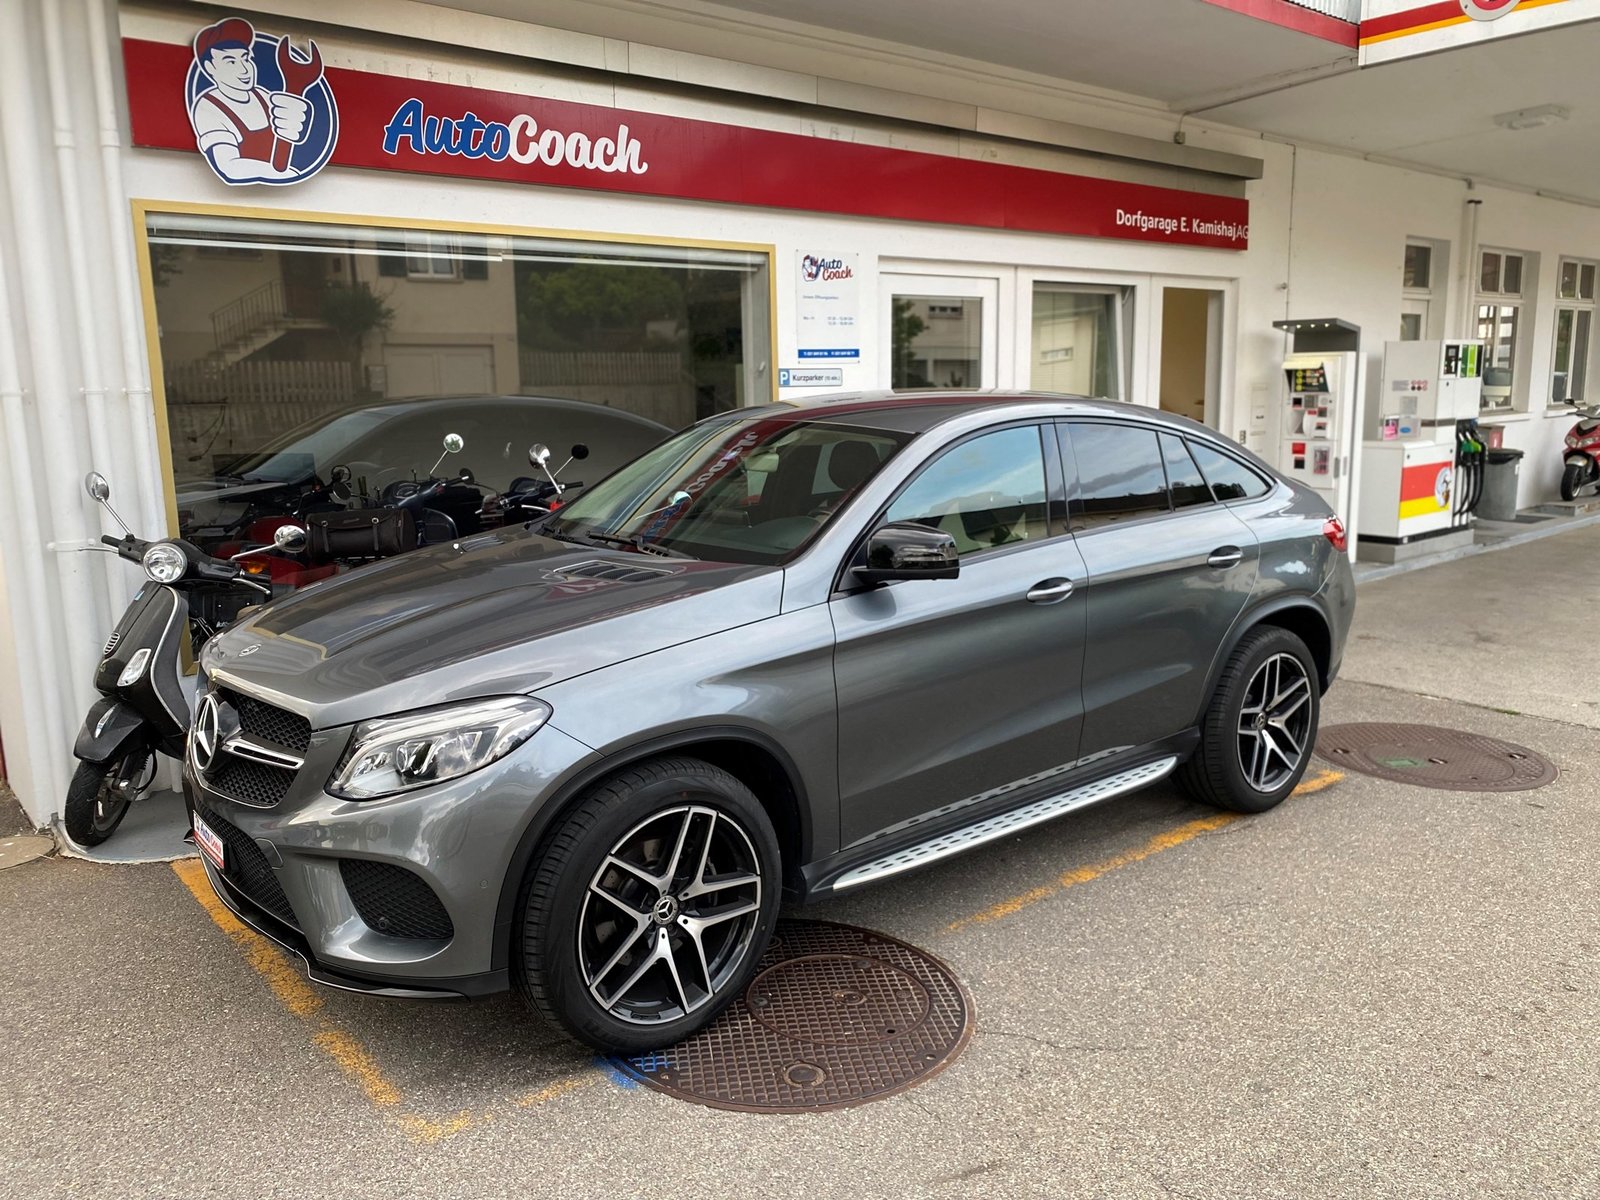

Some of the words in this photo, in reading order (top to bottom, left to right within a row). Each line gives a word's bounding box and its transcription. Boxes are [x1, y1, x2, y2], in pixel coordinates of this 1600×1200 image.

[383, 98, 649, 175] AutoCoach
[1116, 208, 1178, 235] Dorfgarage
[1180, 217, 1190, 232] E.
[819, 258, 843, 270] Auto
[822, 266, 854, 281] Coach
[792, 373, 824, 382] Kurzparker
